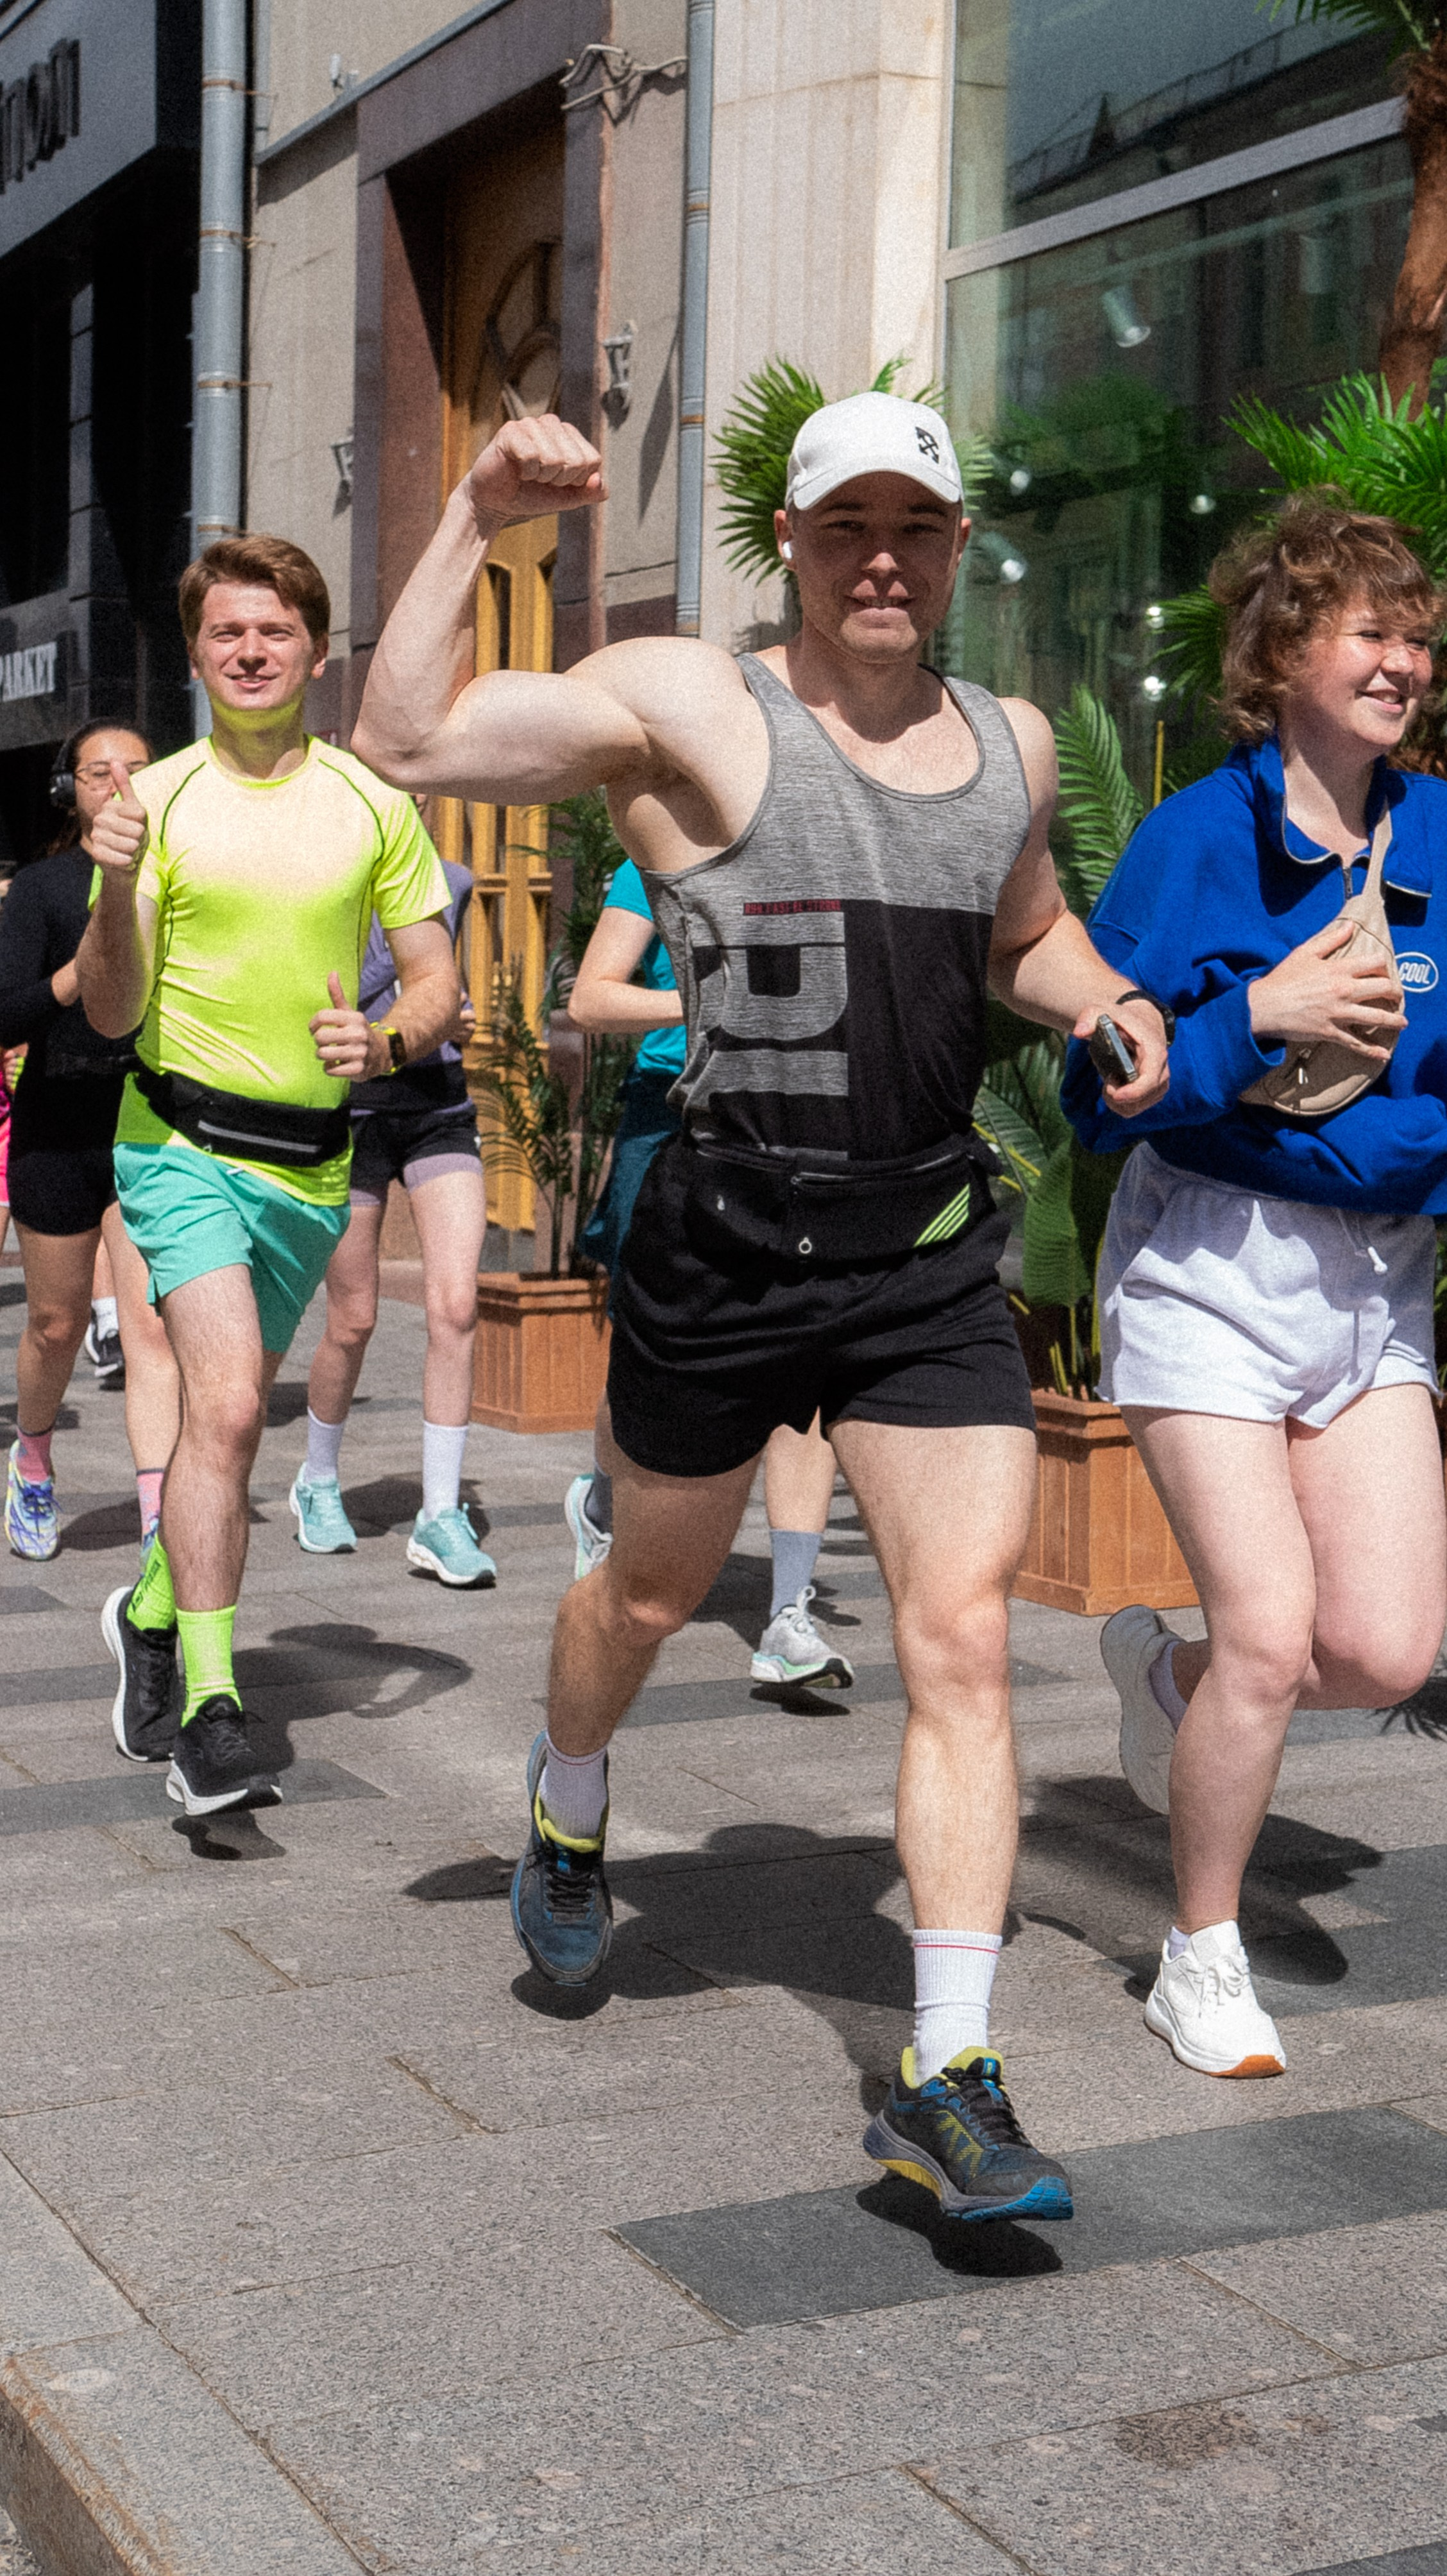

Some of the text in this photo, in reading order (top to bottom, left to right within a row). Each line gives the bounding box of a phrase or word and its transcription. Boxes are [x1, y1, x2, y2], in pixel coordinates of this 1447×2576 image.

[765, 901, 790, 914] FAST
[807, 899, 841, 911] STRONG
[1399, 962, 1430, 984] COOL
